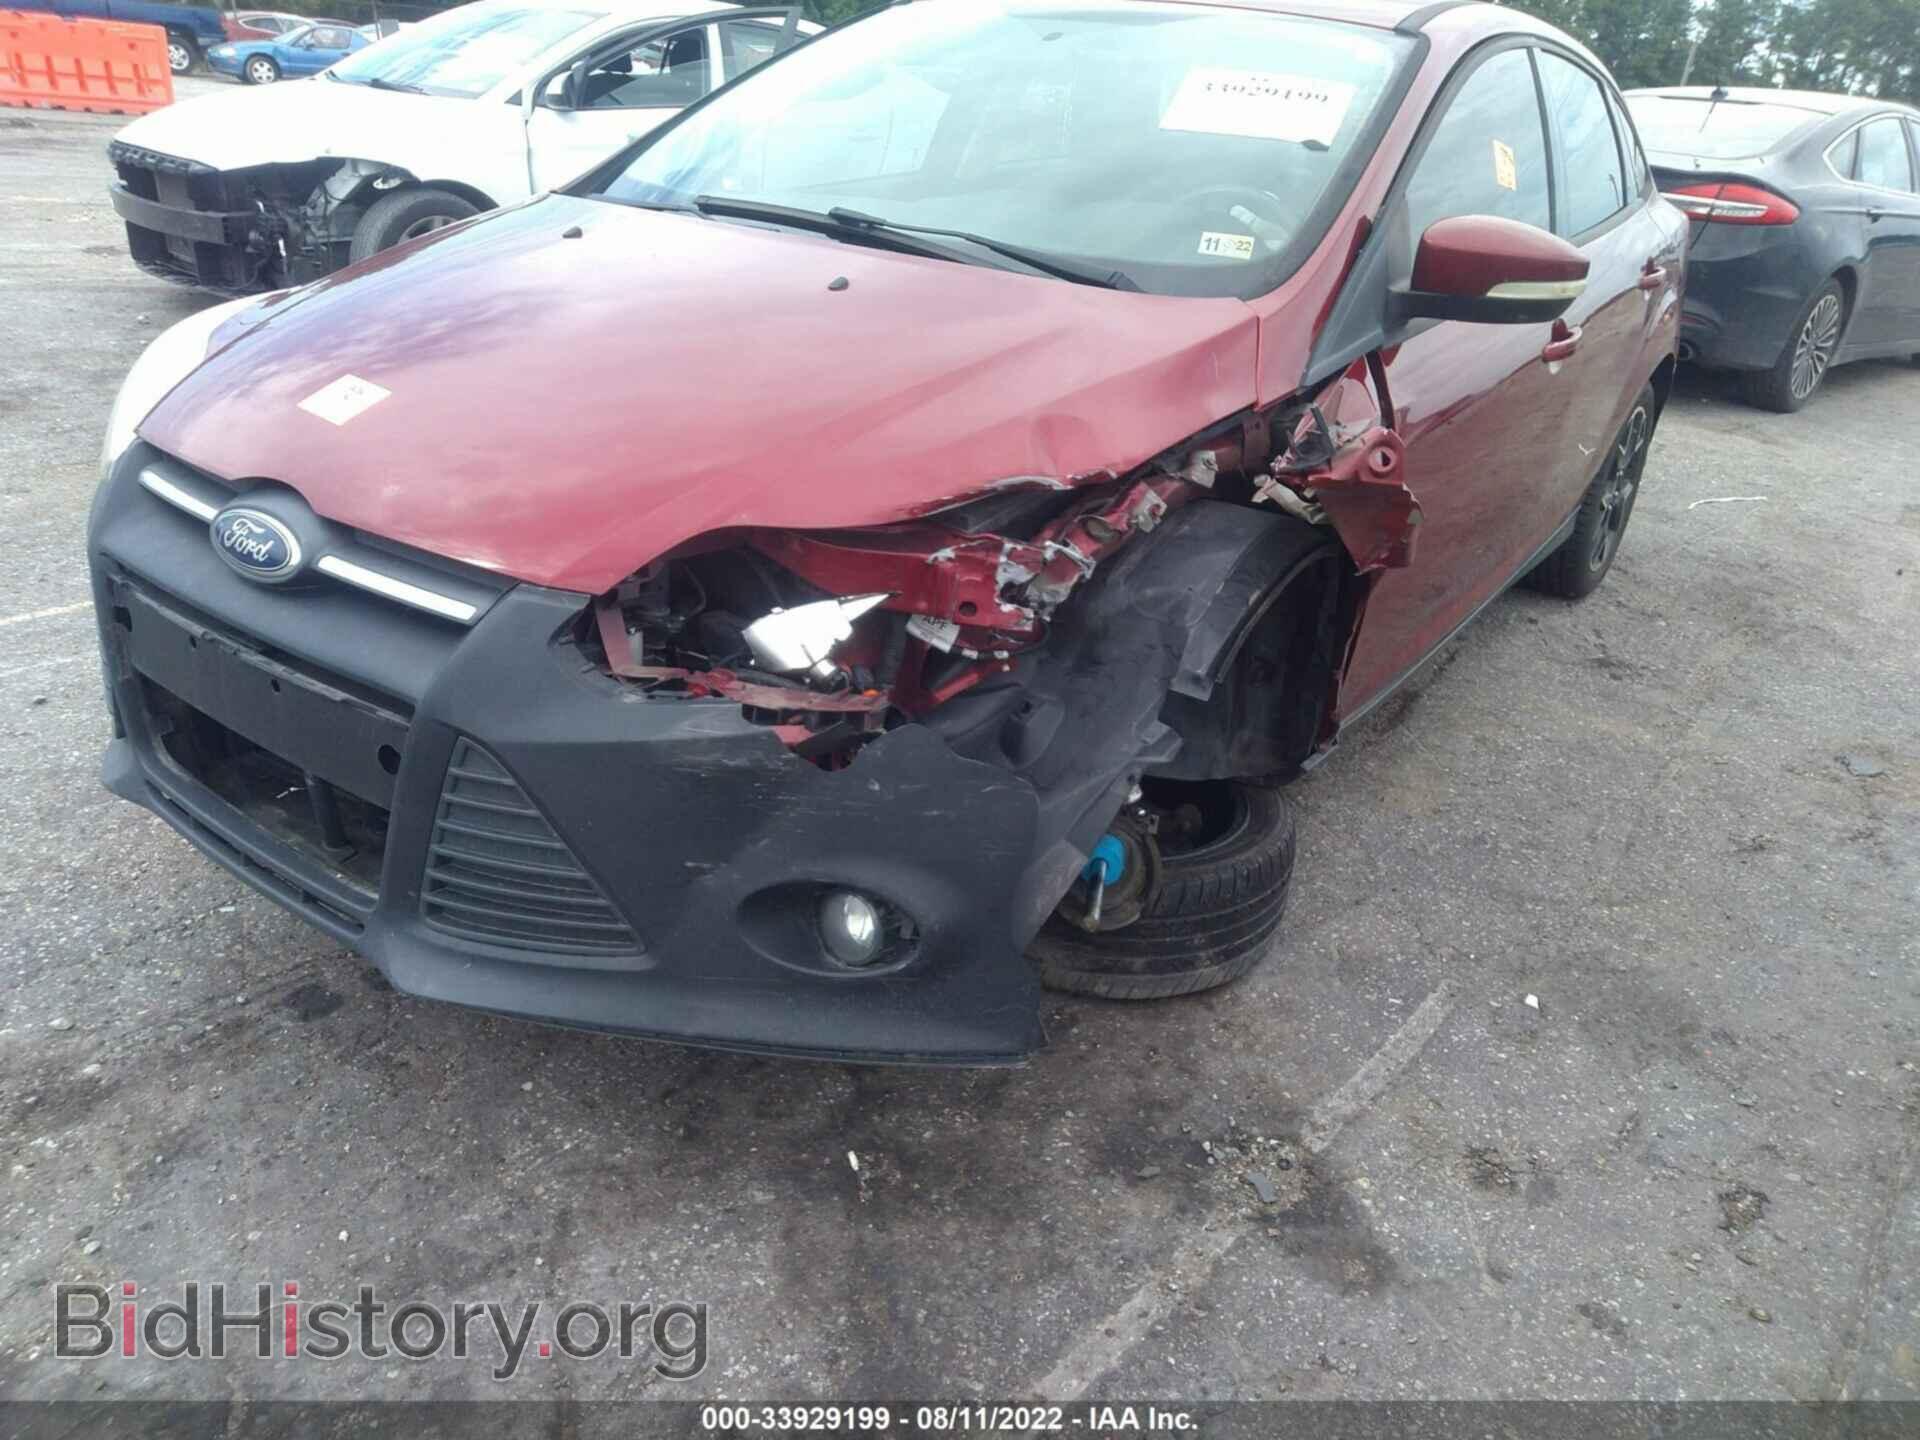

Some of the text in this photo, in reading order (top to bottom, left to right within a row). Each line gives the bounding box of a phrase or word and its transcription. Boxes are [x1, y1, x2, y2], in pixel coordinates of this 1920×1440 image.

[1203, 237, 1252, 253] 11 22
[222, 517, 276, 563] Ford
